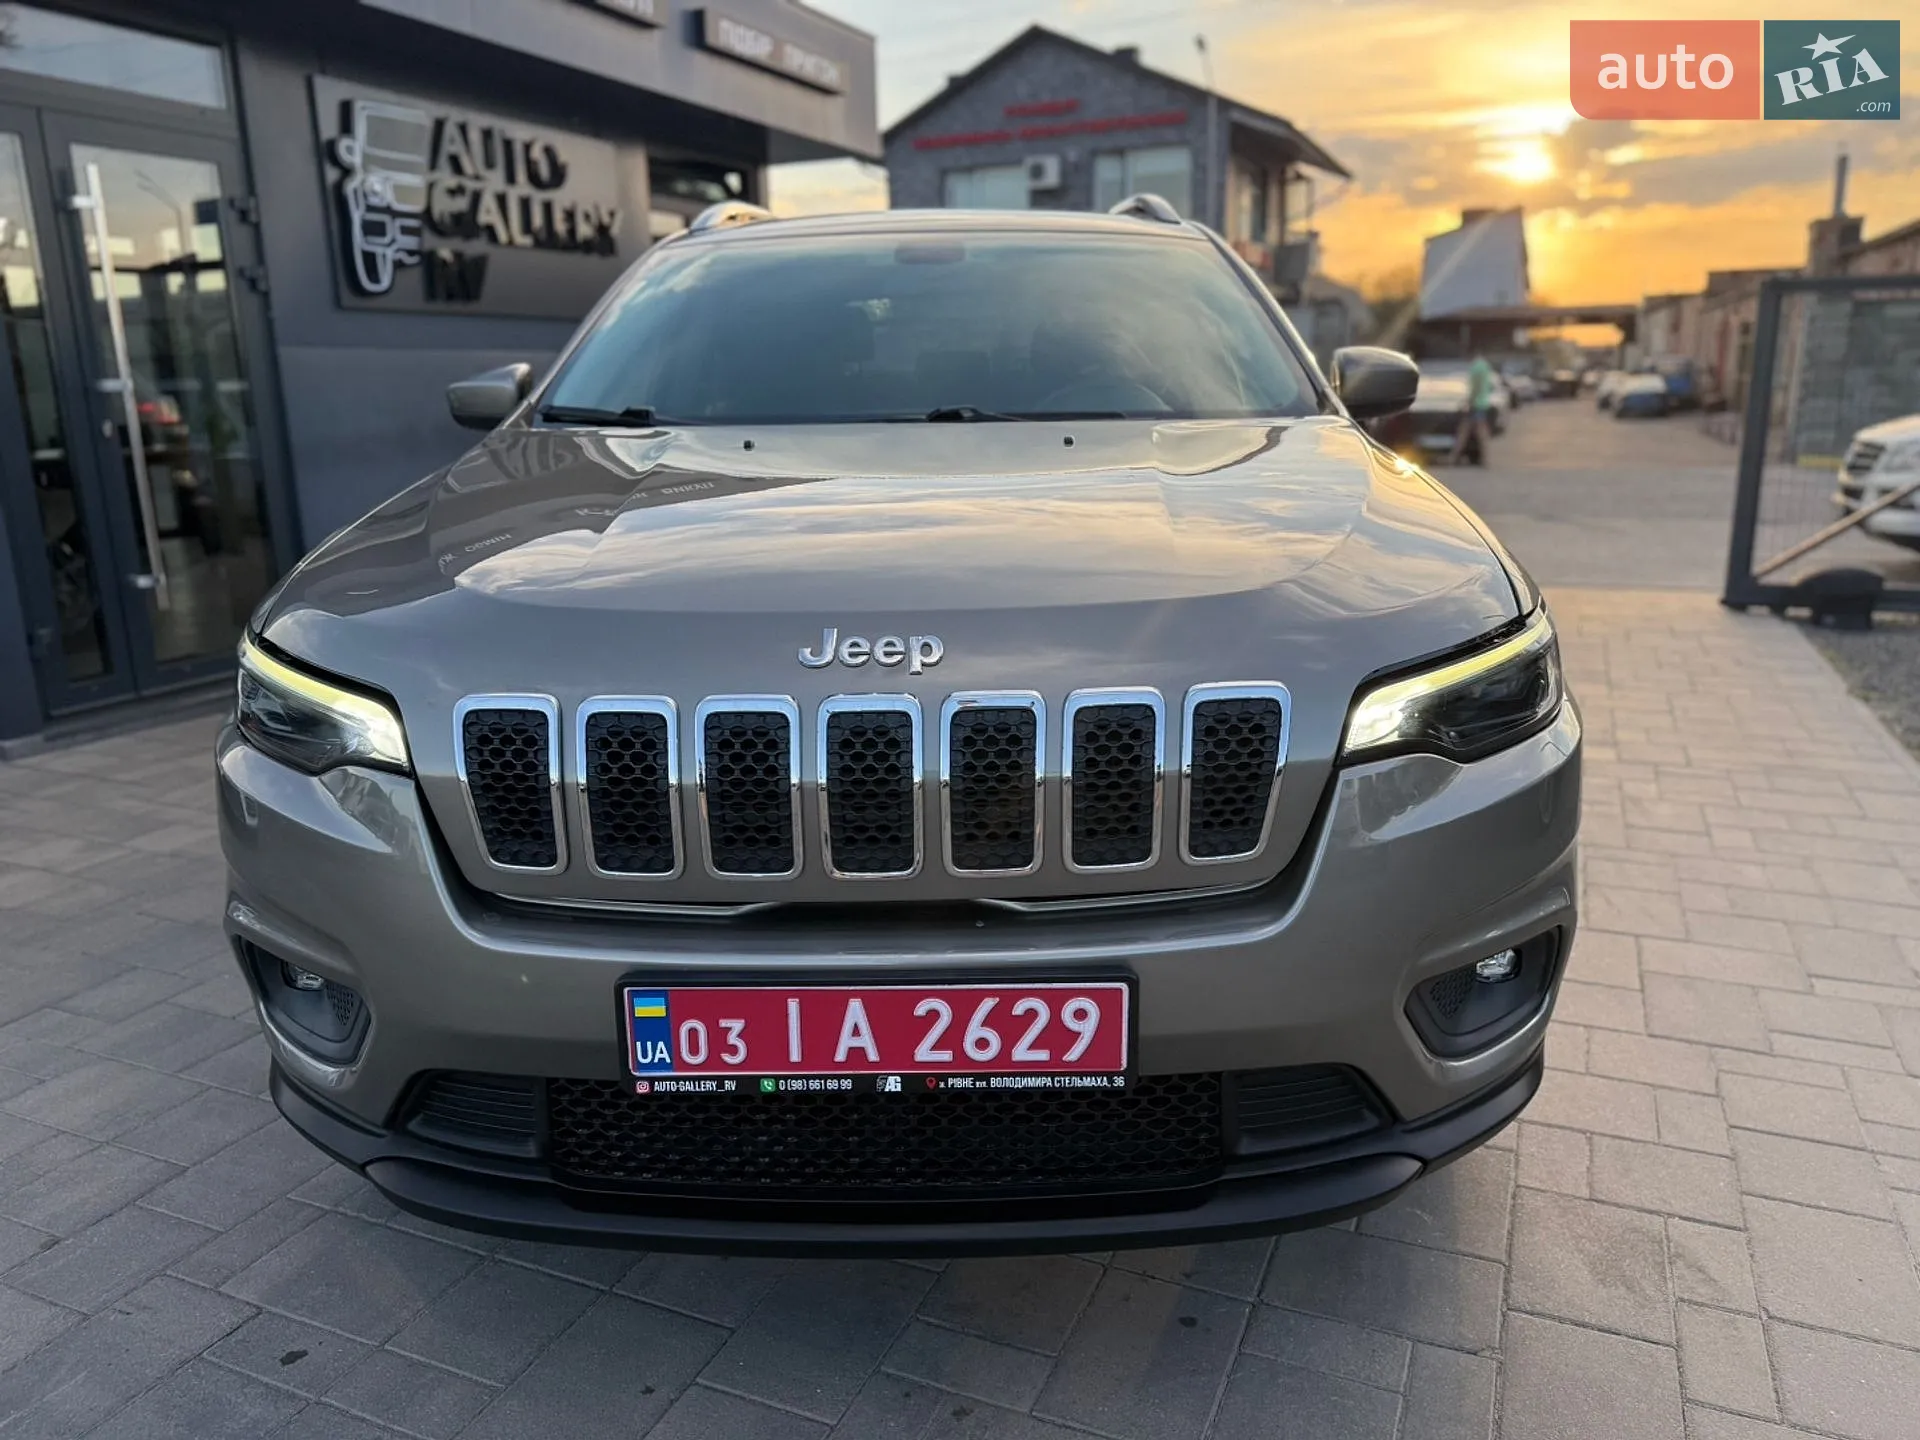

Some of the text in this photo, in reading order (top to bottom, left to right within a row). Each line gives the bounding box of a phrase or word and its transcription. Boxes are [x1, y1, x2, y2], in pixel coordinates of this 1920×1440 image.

[430, 116, 568, 190] AUTO
[422, 178, 624, 258] GALLERY
[797, 628, 945, 675] Jeep
[636, 1041, 671, 1064] UA
[678, 1019, 748, 1065] 03
[913, 998, 1101, 1063] 2629
[948, 1077, 974, 1088] РІВНЕ
[990, 1076, 1052, 1089] ВОЛОДИМИРА
[1112, 1076, 1125, 1087] 36
